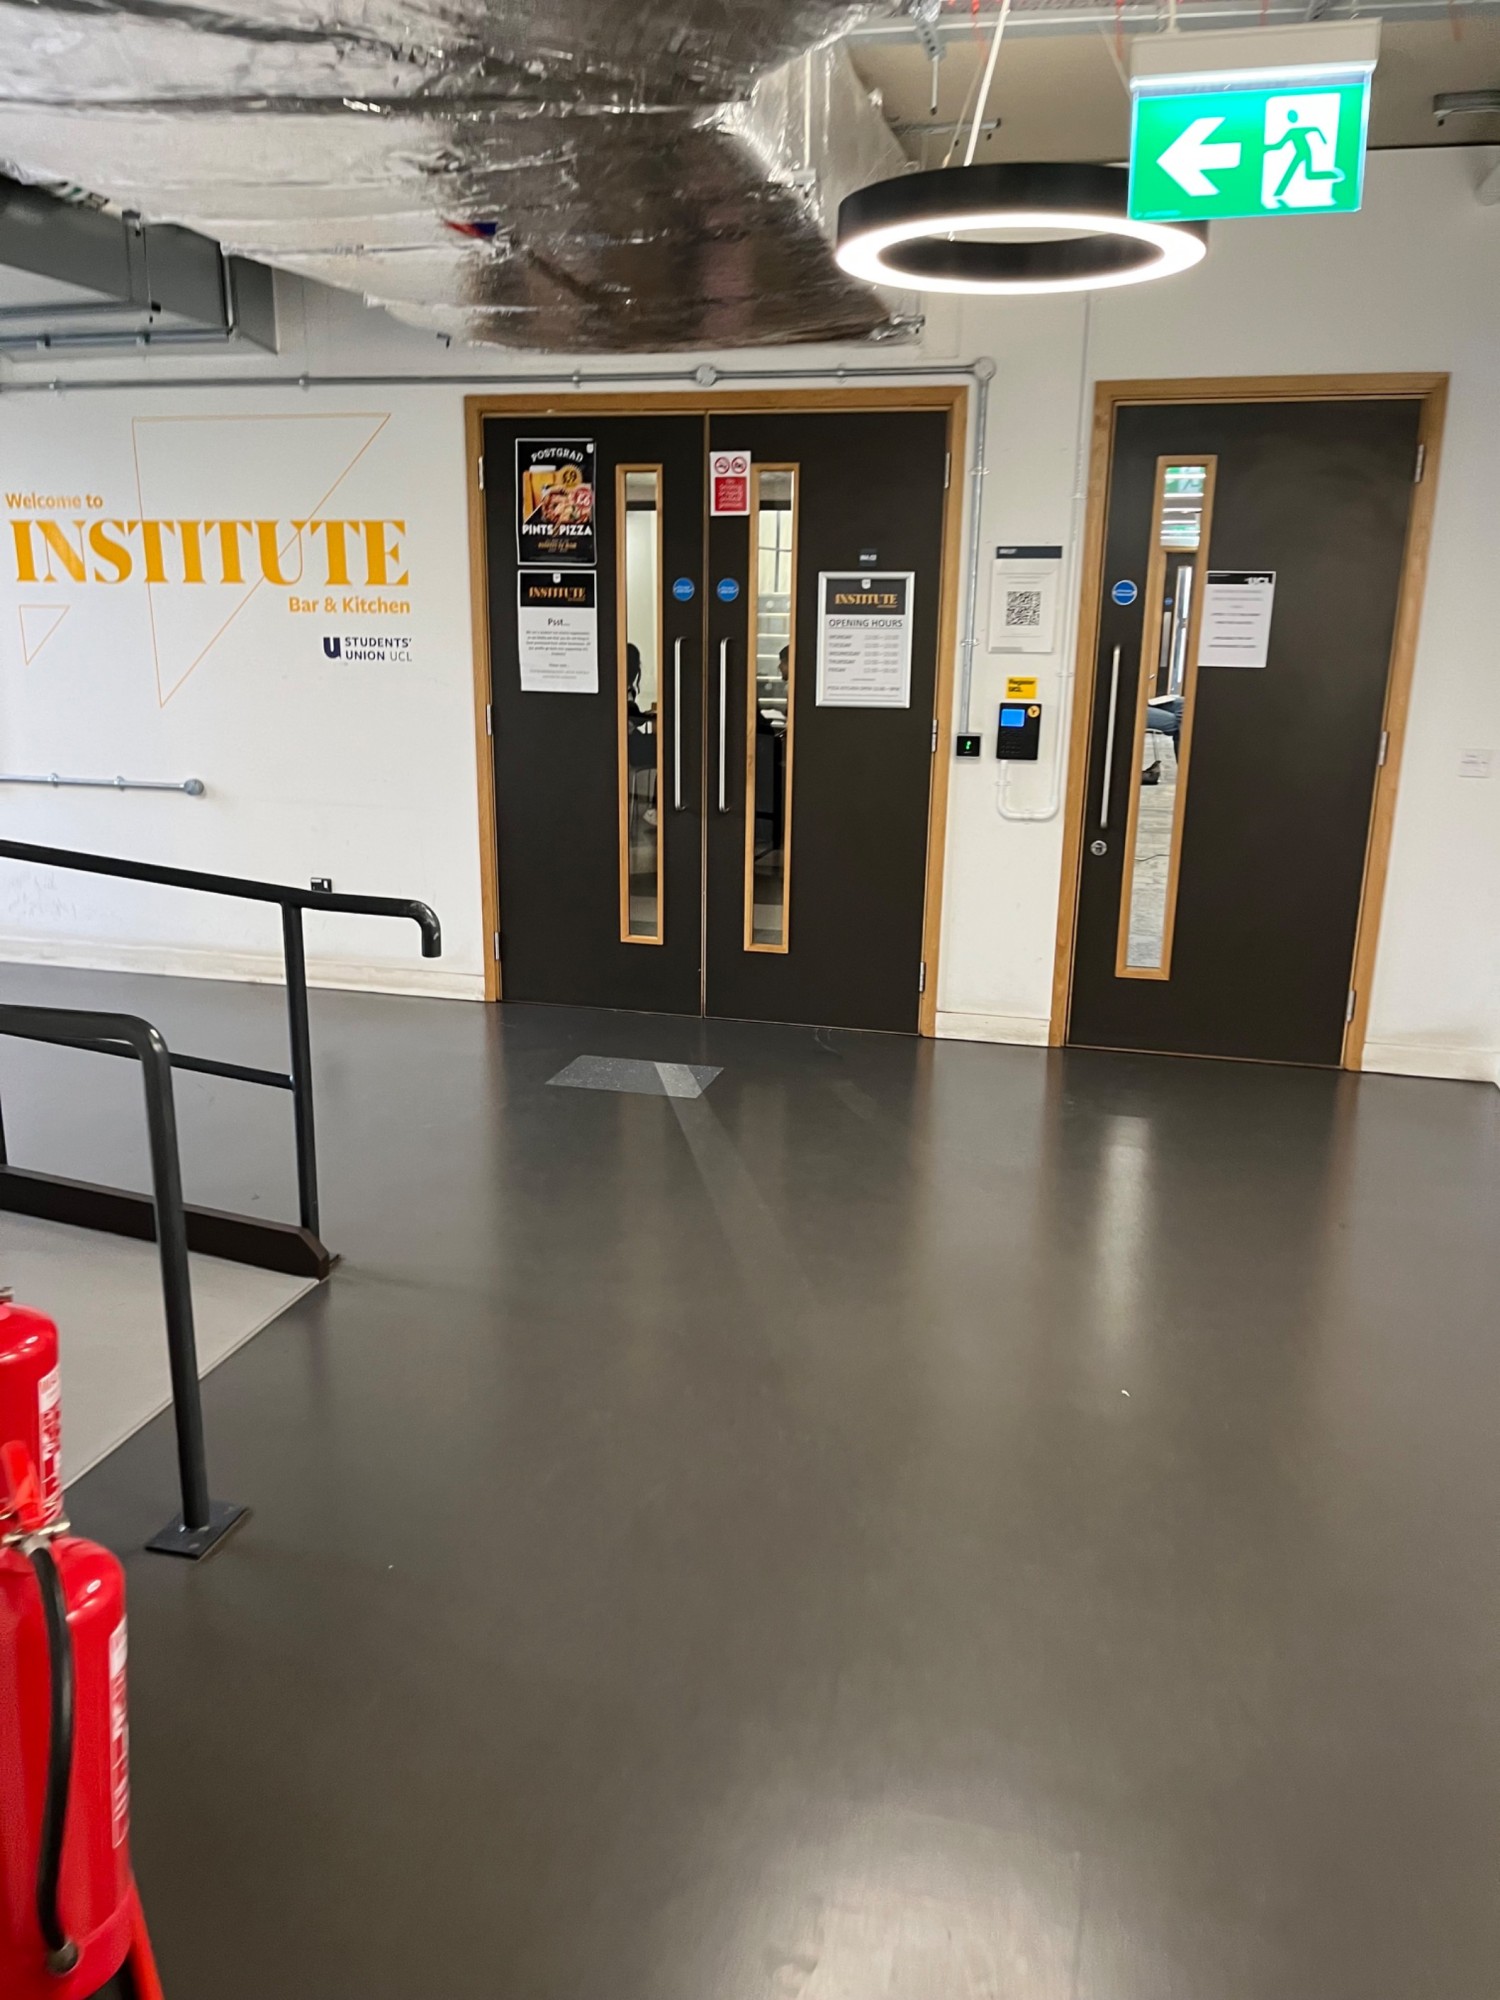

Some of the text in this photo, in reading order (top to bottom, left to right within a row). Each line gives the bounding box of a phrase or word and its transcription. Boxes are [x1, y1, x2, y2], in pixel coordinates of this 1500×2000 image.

[530, 447, 584, 463] POSTGRAD
[5, 492, 104, 509] Welcome to
[522, 524, 593, 536] PINTS PIZZA
[9, 518, 410, 587] INSTITUTE
[528, 586, 587, 599] INSTITUTE
[289, 596, 412, 614] Bar & Kitchen
[834, 593, 899, 606] INSTITUTE
[828, 619, 903, 628] OPENING HOURS
[345, 636, 412, 649] STUDENTS'
[345, 650, 412, 662] UNION UCL
